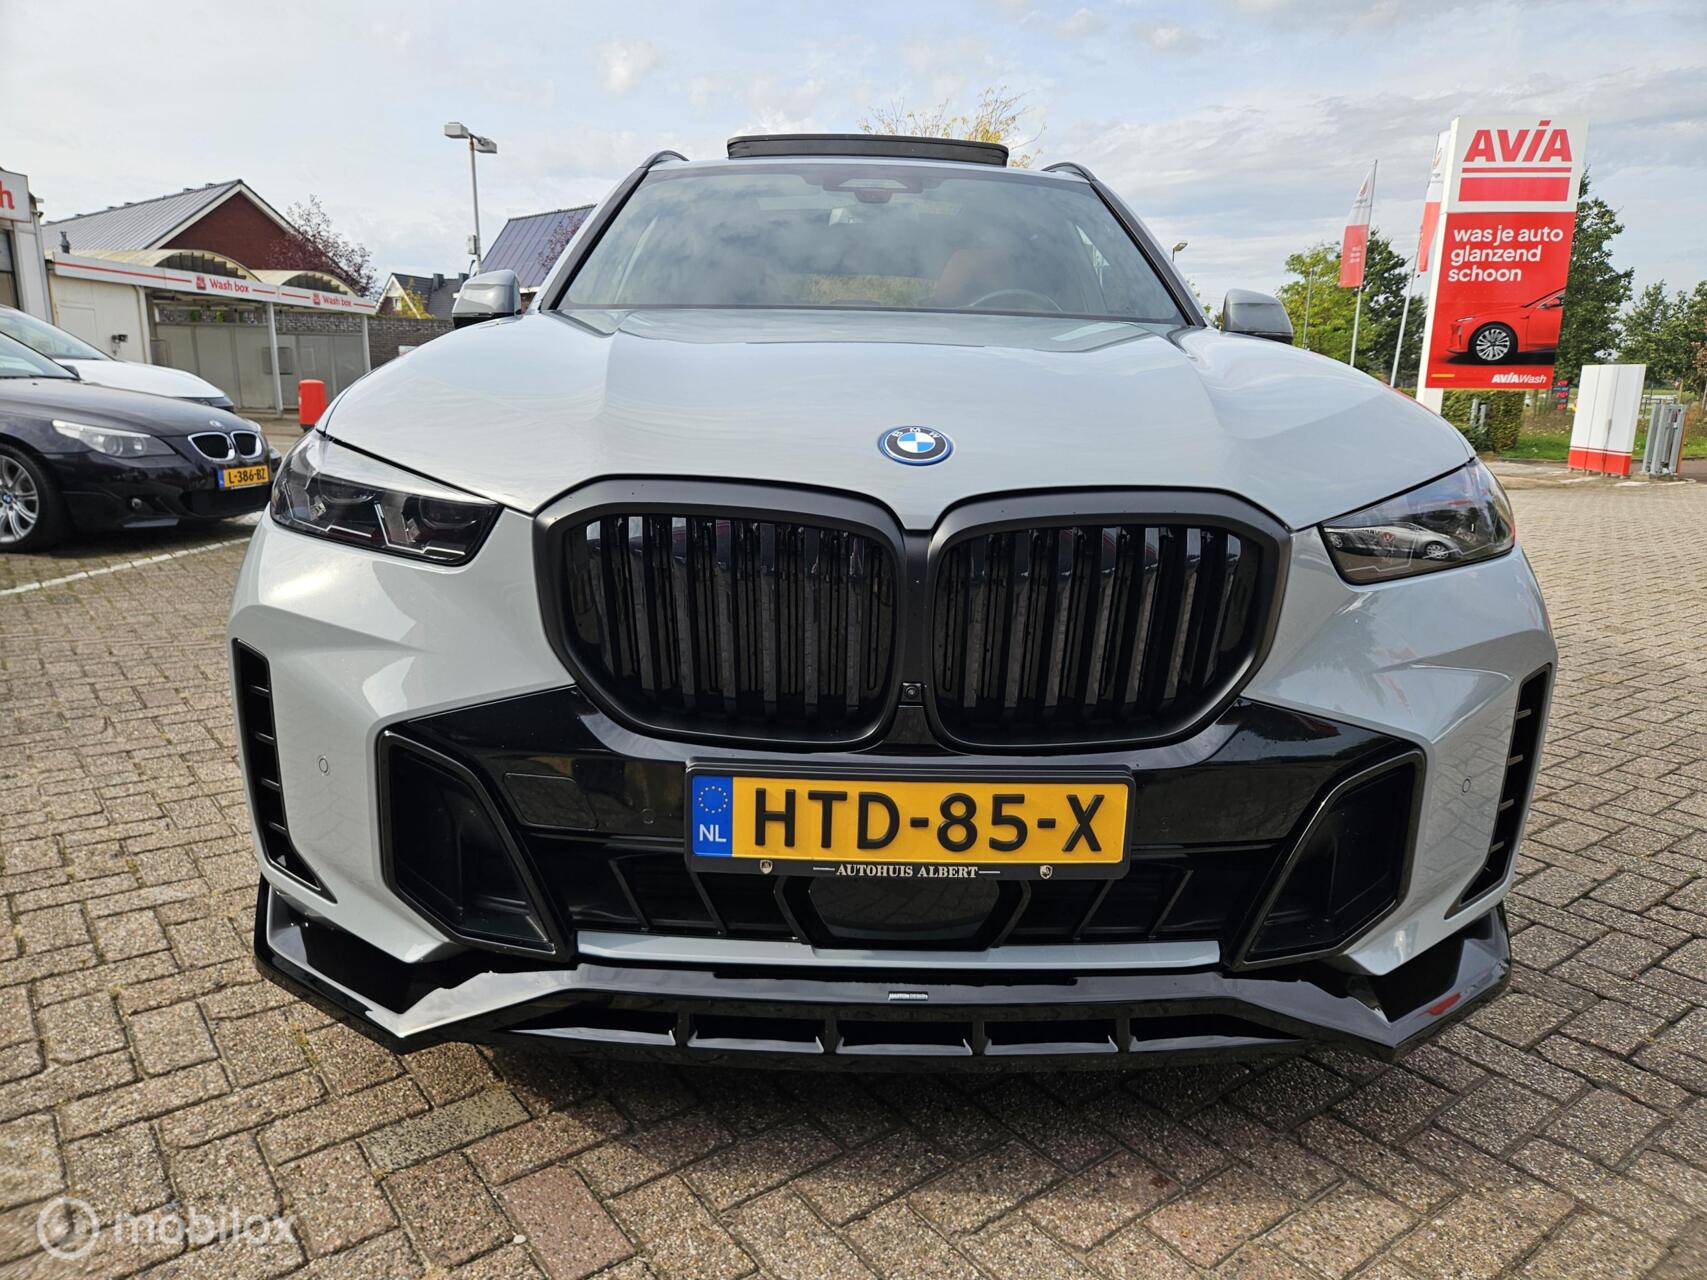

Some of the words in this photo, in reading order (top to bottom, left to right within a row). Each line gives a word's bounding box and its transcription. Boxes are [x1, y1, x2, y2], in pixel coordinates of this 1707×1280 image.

[1453, 228, 1493, 243] was
[1495, 225, 1518, 245] je
[1519, 227, 1564, 243] auto
[1450, 245, 1542, 266] glanzend
[1447, 265, 1522, 283] schoon
[209, 278, 233, 291] Wash
[234, 281, 249, 293] box
[323, 295, 340, 306] Wash
[228, 467, 267, 484] L-386-BZ
[754, 787, 1106, 853] HTD-85-X
[699, 824, 727, 843] NL
[836, 863, 914, 878] AUTOHUIS
[917, 866, 978, 879] ALBERT
